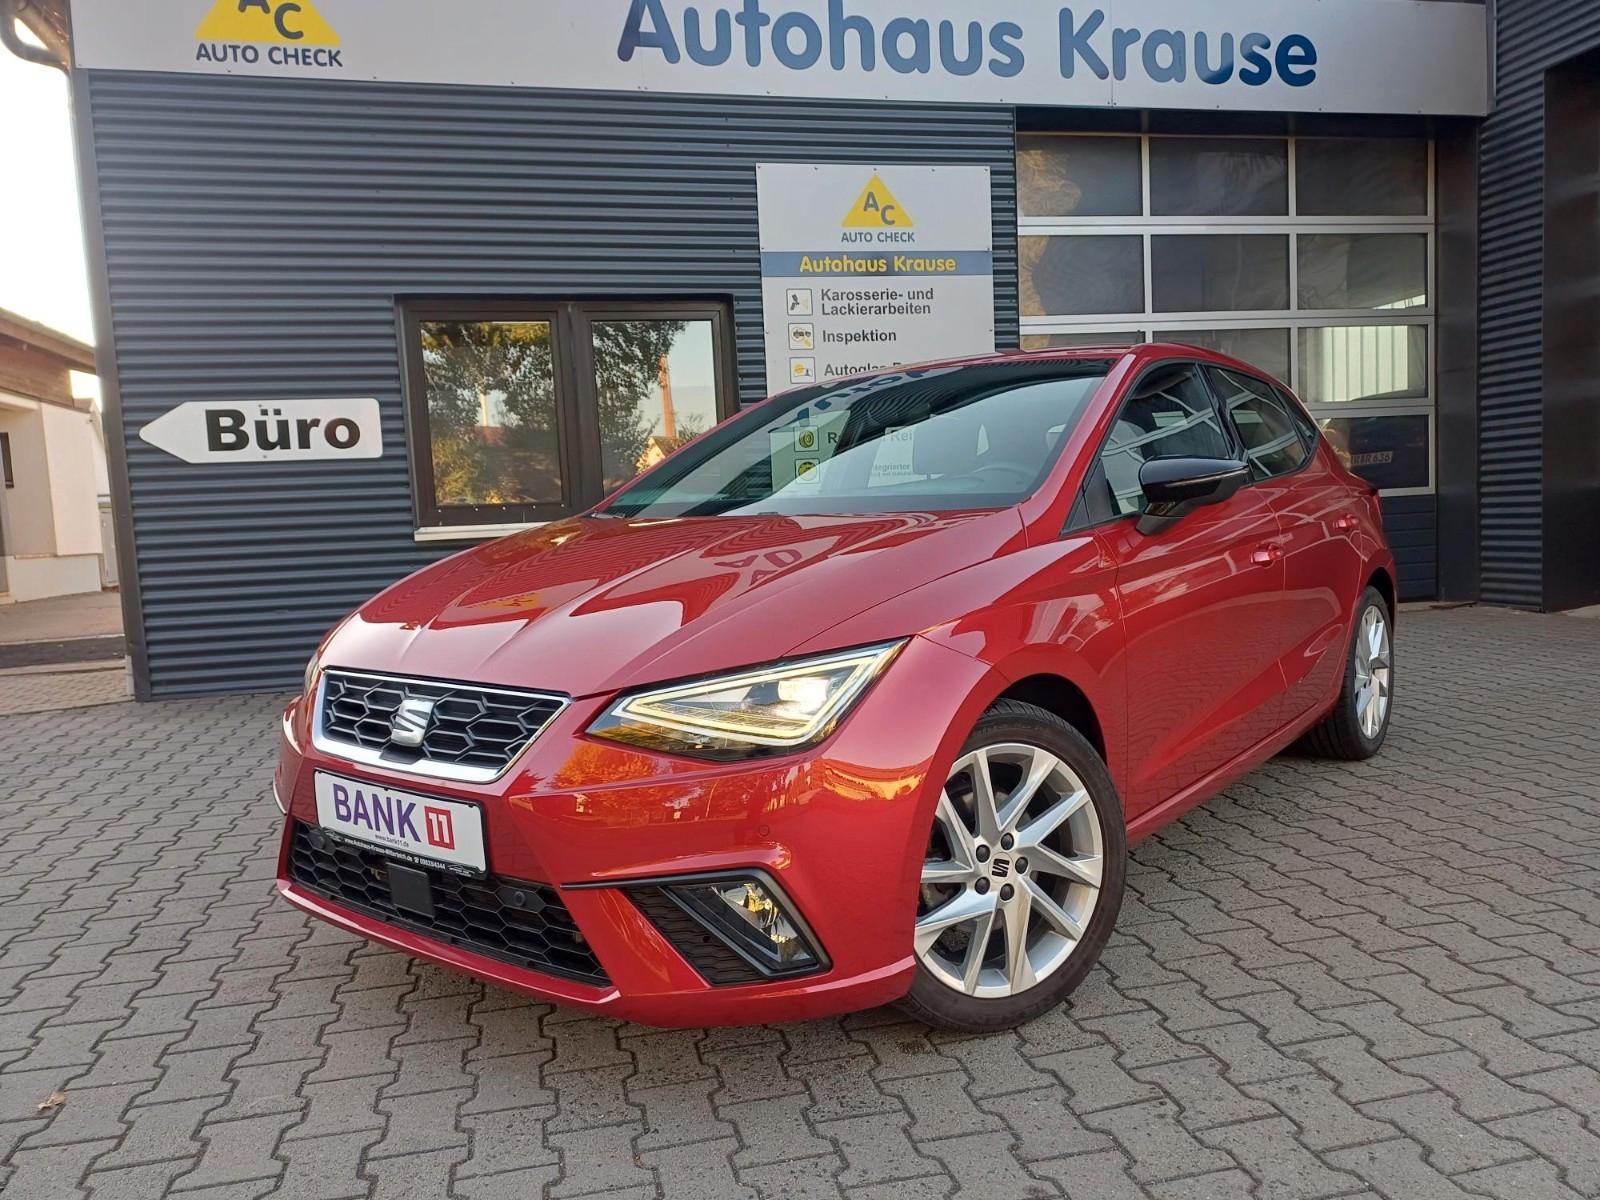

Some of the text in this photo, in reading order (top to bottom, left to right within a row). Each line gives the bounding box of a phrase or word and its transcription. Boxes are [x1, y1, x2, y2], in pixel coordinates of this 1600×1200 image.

[617, 0, 1318, 88] Autohaus Krause
[196, 43, 343, 68] AUTO CHECK
[841, 231, 916, 243] AUTO CHECK
[800, 255, 957, 273] Autohaus Krause
[820, 287, 934, 302] Karosserie- und
[821, 302, 932, 316] Lackierarbeiten
[822, 329, 897, 344] Inspektion
[205, 408, 361, 452] Büro
[332, 783, 451, 845] BANK 11
